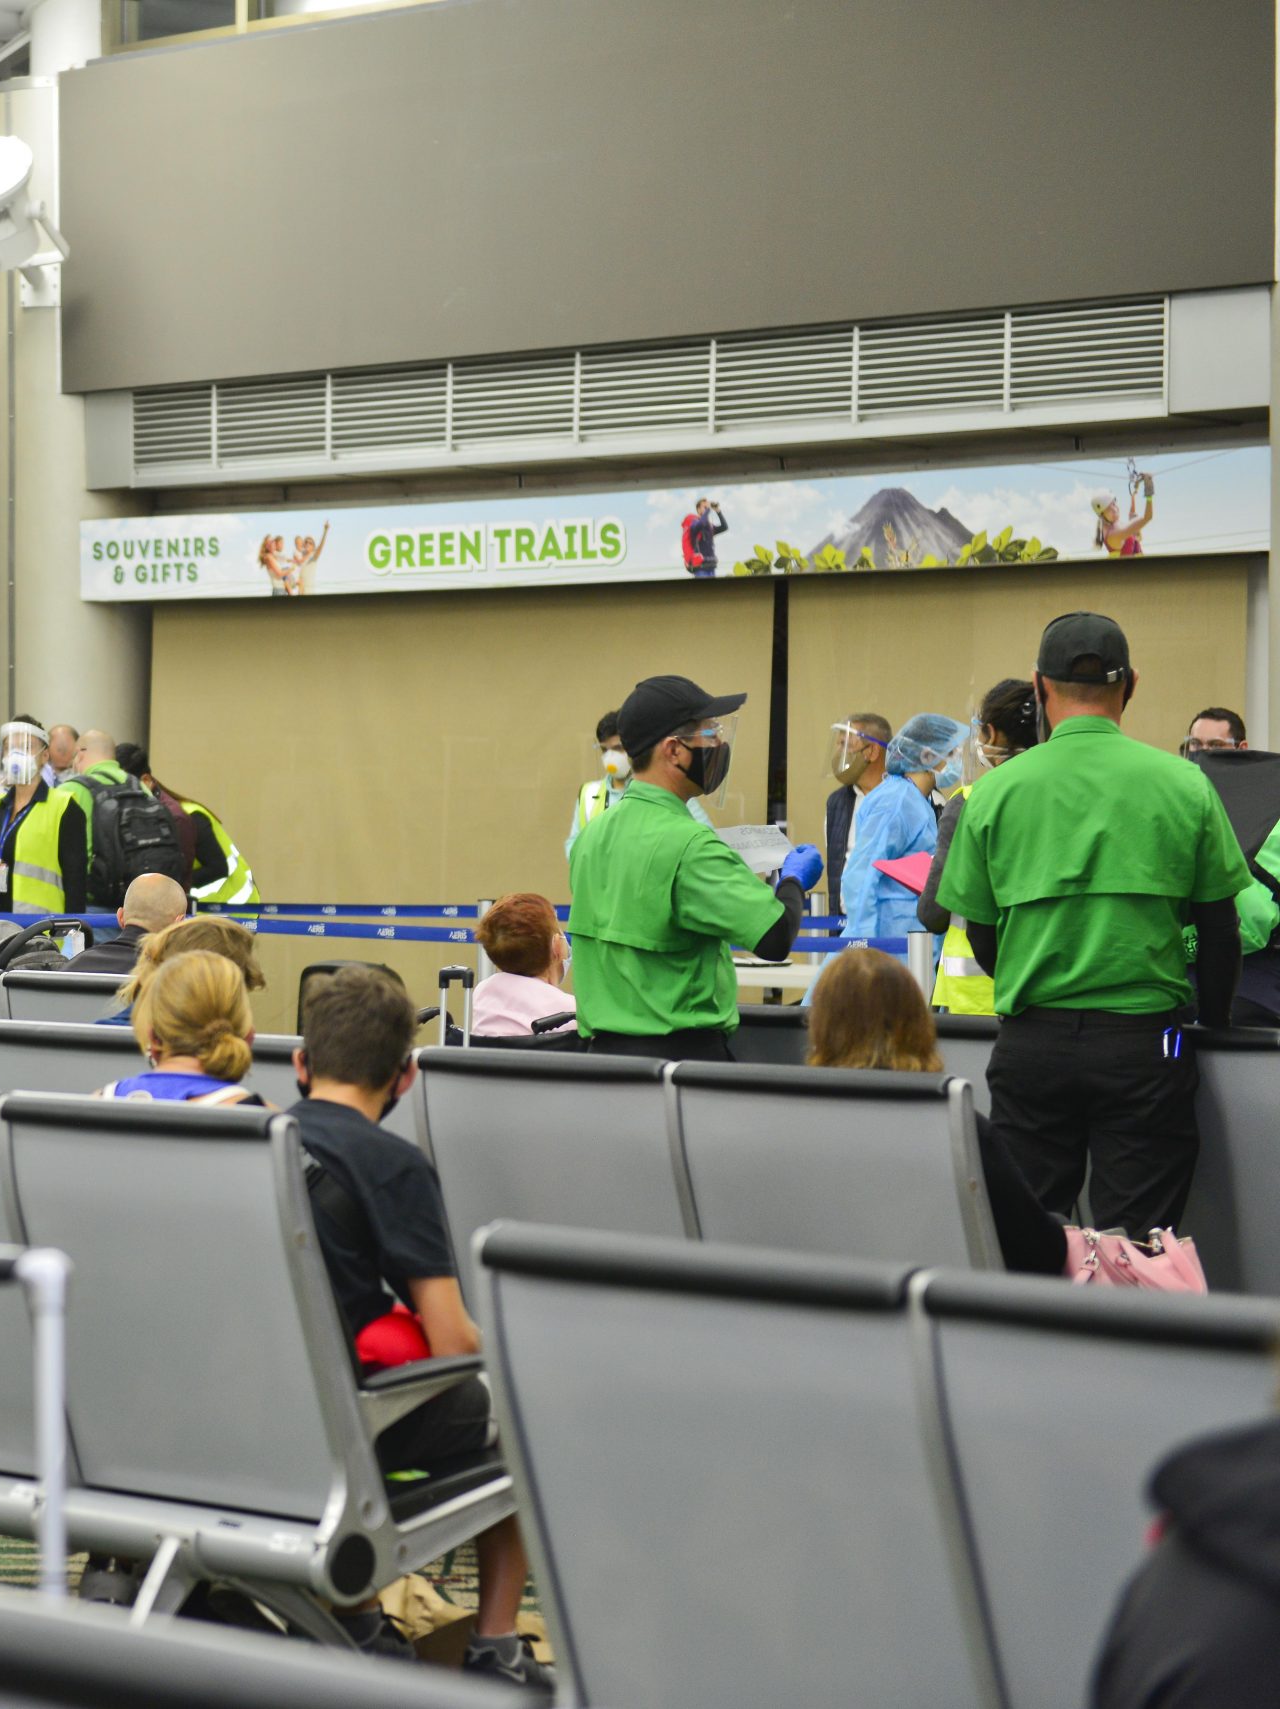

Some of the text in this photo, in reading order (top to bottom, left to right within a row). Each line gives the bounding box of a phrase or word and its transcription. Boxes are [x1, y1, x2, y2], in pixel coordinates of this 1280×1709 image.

[92, 536, 220, 560] SOUVENIRS
[369, 522, 621, 569] GREEN TRAILS
[113, 562, 199, 584] & GIFTS
